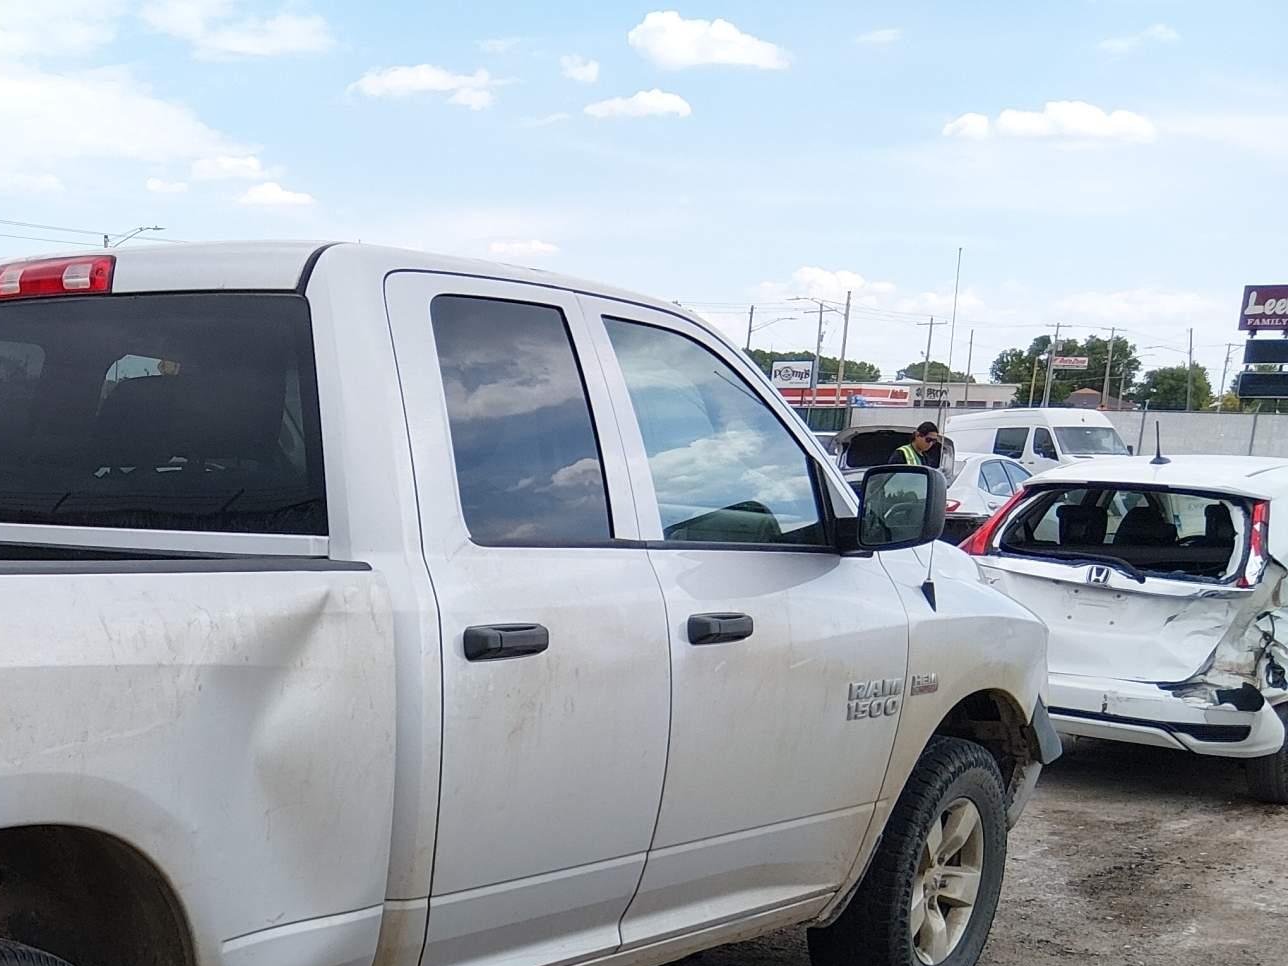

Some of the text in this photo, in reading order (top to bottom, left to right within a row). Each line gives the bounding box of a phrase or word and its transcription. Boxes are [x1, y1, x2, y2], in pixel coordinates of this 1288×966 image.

[1244, 290, 1288, 315] Lee
[1247, 318, 1288, 326] FAMILY
[848, 679, 903, 701] RAM
[847, 697, 900, 721] 1500
